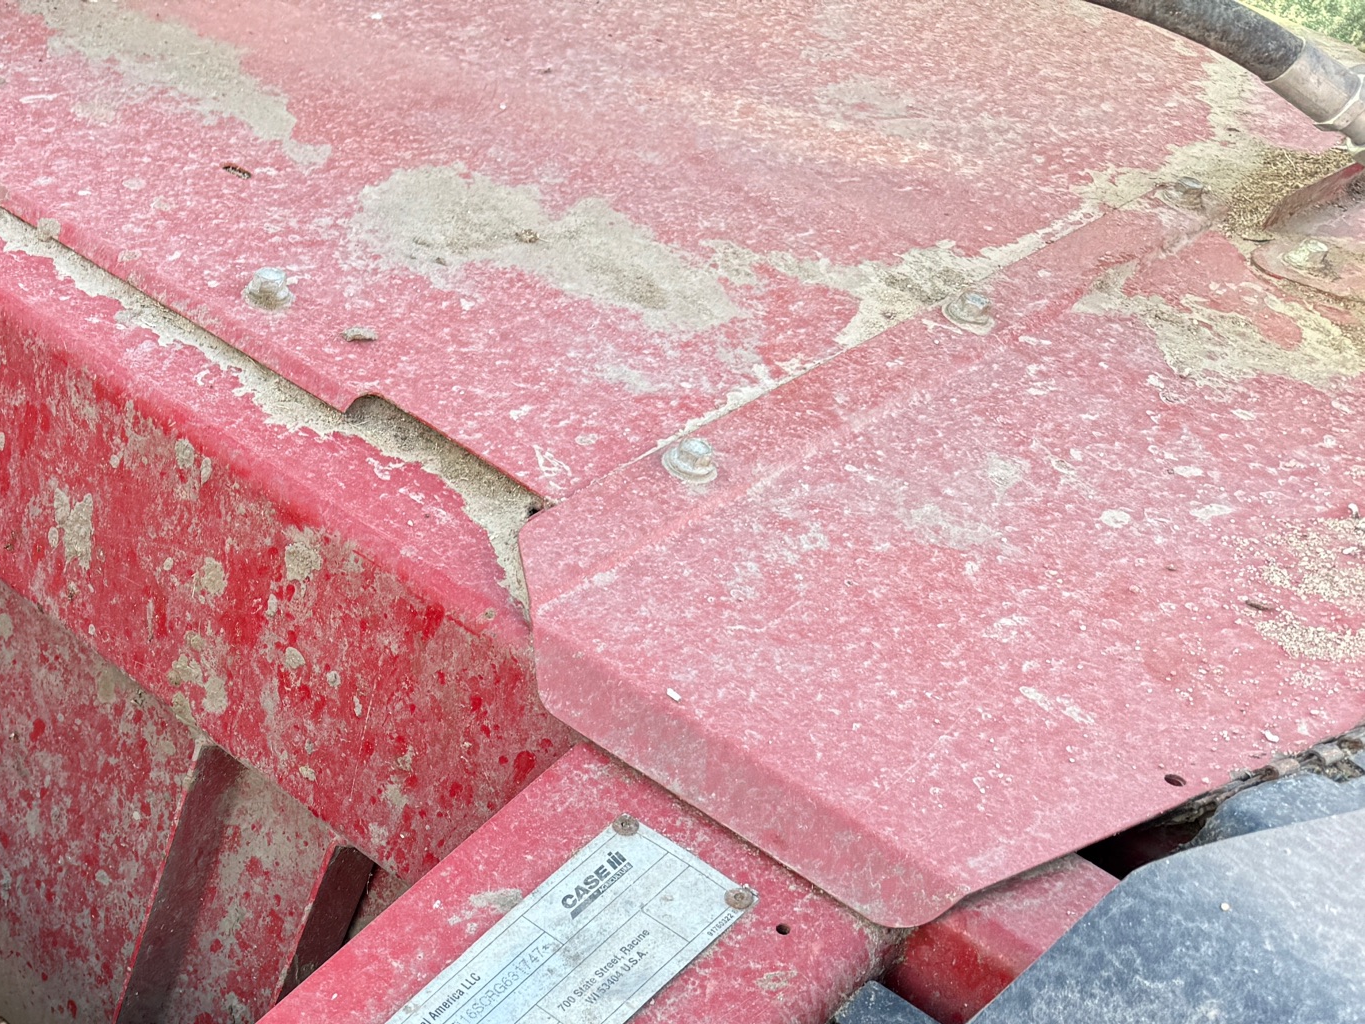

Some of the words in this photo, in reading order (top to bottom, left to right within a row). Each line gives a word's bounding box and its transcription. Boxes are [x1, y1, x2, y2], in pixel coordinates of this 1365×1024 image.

[561, 864, 611, 909] CASE
[597, 862, 632, 893] AGRICULTURE
[557, 995, 577, 1012] 700
[572, 975, 597, 997] State
[593, 952, 625, 979] Street,
[619, 927, 651, 955] Racine
[584, 991, 600, 1005] WI
[596, 970, 624, 994] 53404
[620, 947, 649, 973] U.S.A.
[426, 986, 465, 1020] America
[459, 971, 482, 990] LLC
